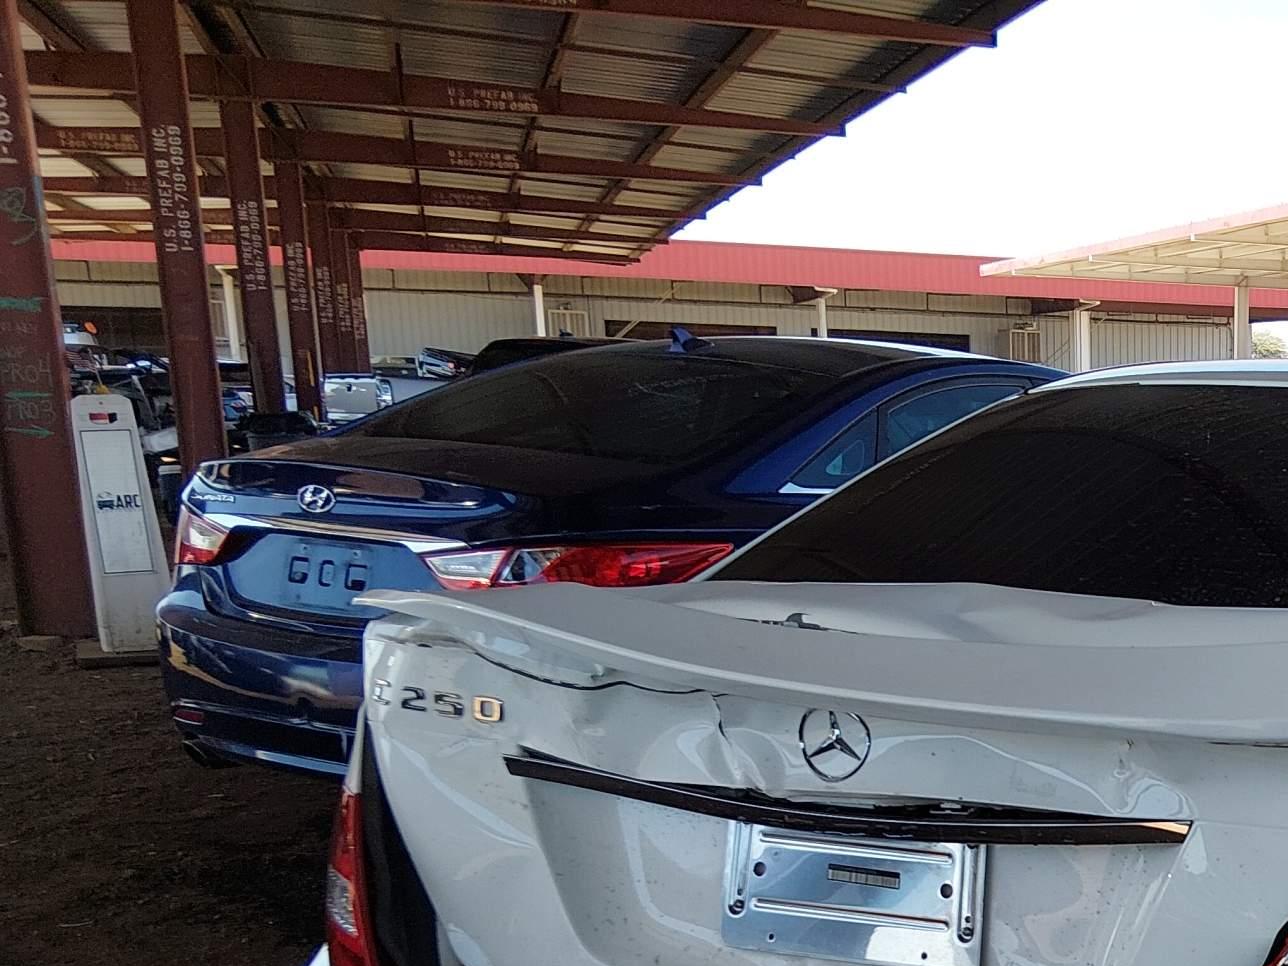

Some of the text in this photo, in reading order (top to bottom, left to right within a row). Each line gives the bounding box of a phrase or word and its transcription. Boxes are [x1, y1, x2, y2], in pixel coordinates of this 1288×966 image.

[152, 123, 179, 252] U.S. PREFAB INC.
[115, 493, 141, 510] ARC
